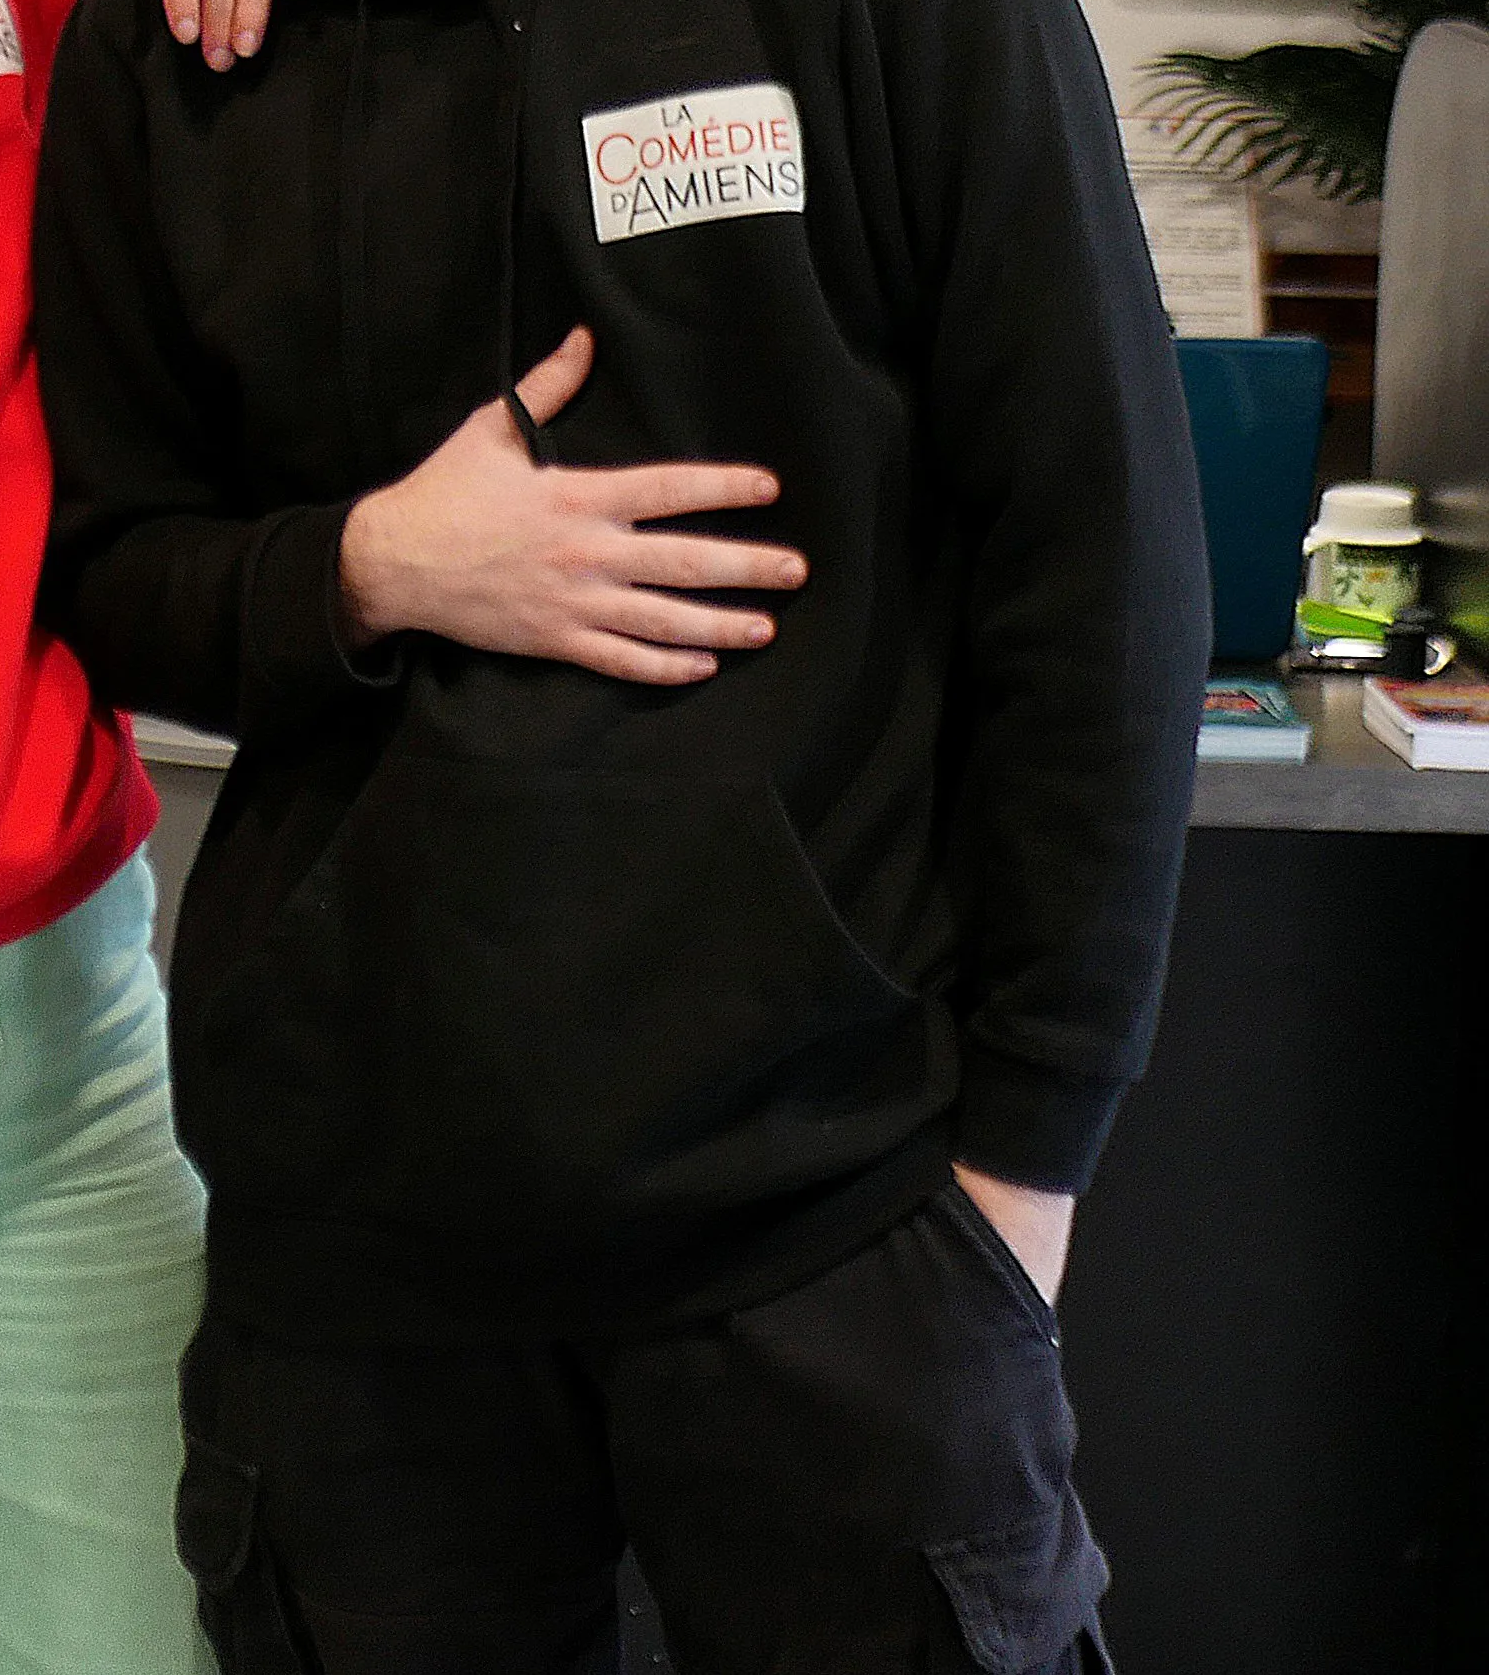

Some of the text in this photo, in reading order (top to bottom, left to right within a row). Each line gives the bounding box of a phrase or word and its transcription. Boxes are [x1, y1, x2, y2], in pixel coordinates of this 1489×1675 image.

[661, 103, 694, 128] LA
[597, 116, 791, 185] COMÉDIE
[611, 161, 800, 233] D'AMIENS
